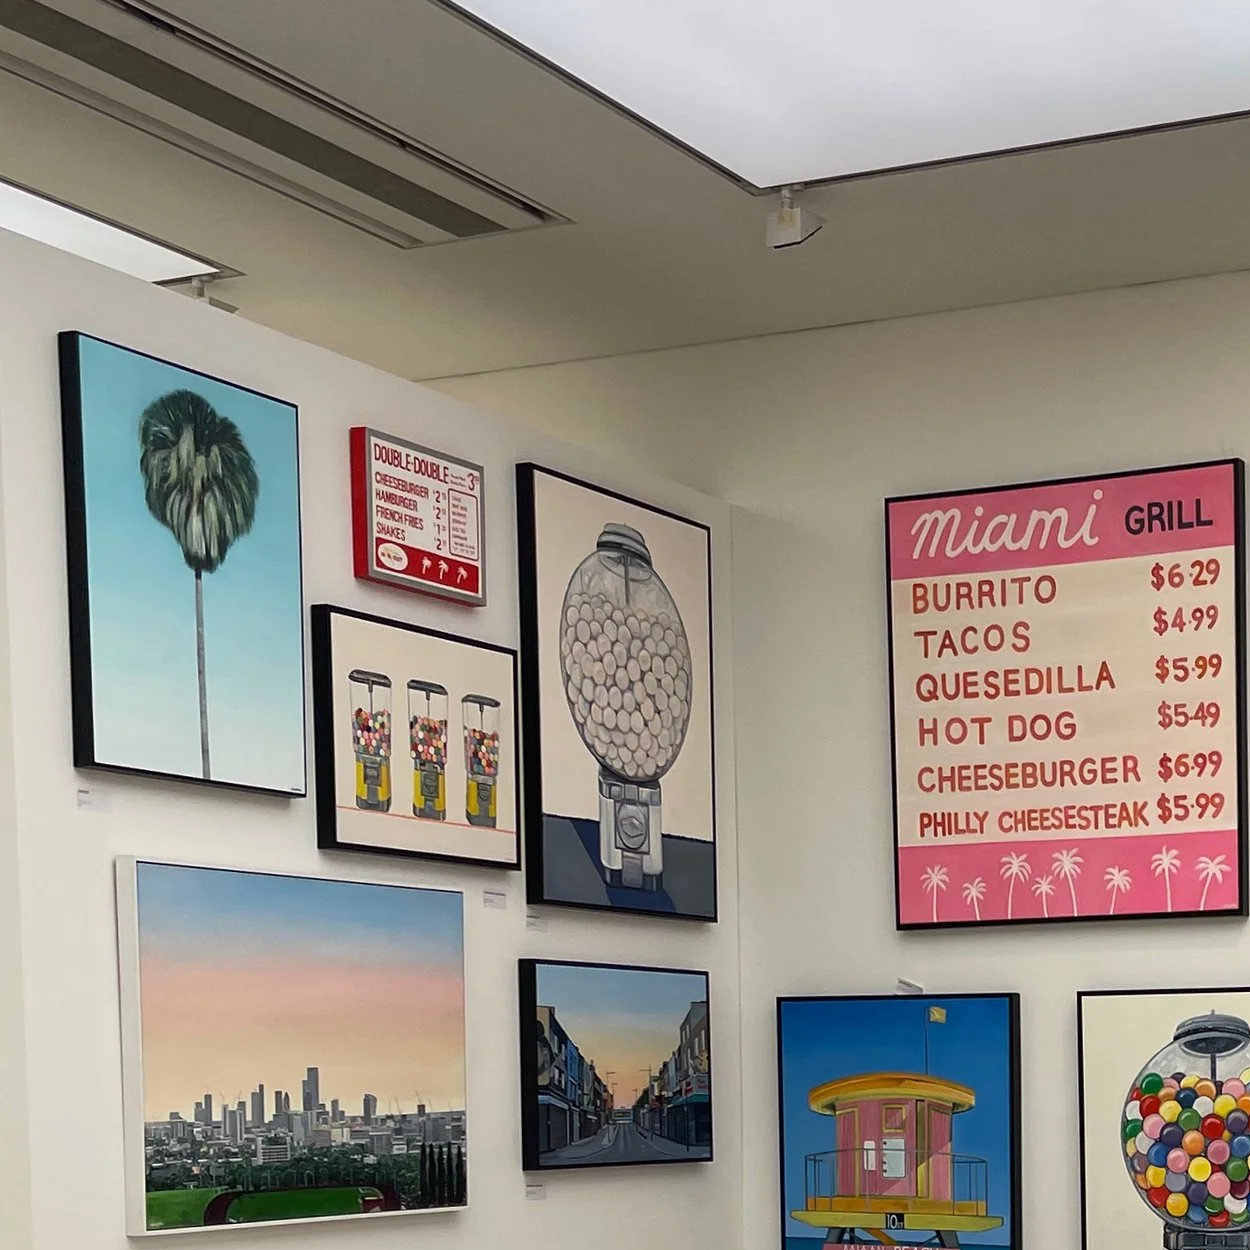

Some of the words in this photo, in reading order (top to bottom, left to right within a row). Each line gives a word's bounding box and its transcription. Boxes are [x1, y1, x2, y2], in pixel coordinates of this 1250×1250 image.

[374, 443, 449, 484] DOUBLE-DOUBLE
[375, 471, 429, 500] CHEESEBURGER
[375, 488, 418, 512] HAMBURGER
[376, 504, 404, 524] FRENCH
[404, 514, 424, 530] FRIES
[376, 521, 406, 541] SHAKES
[1125, 499, 1213, 535] GRILL
[912, 575, 1057, 614] BURRITO
[914, 621, 1031, 658] TACOS
[915, 660, 1116, 702] QUESEDILLA
[919, 717, 992, 746] HOT
[1008, 711, 1077, 742] DOG
[917, 755, 1141, 793] CHEESEBURGER
[919, 810, 990, 838] PHILLY
[997, 801, 1149, 833] CHEESESTEAK
